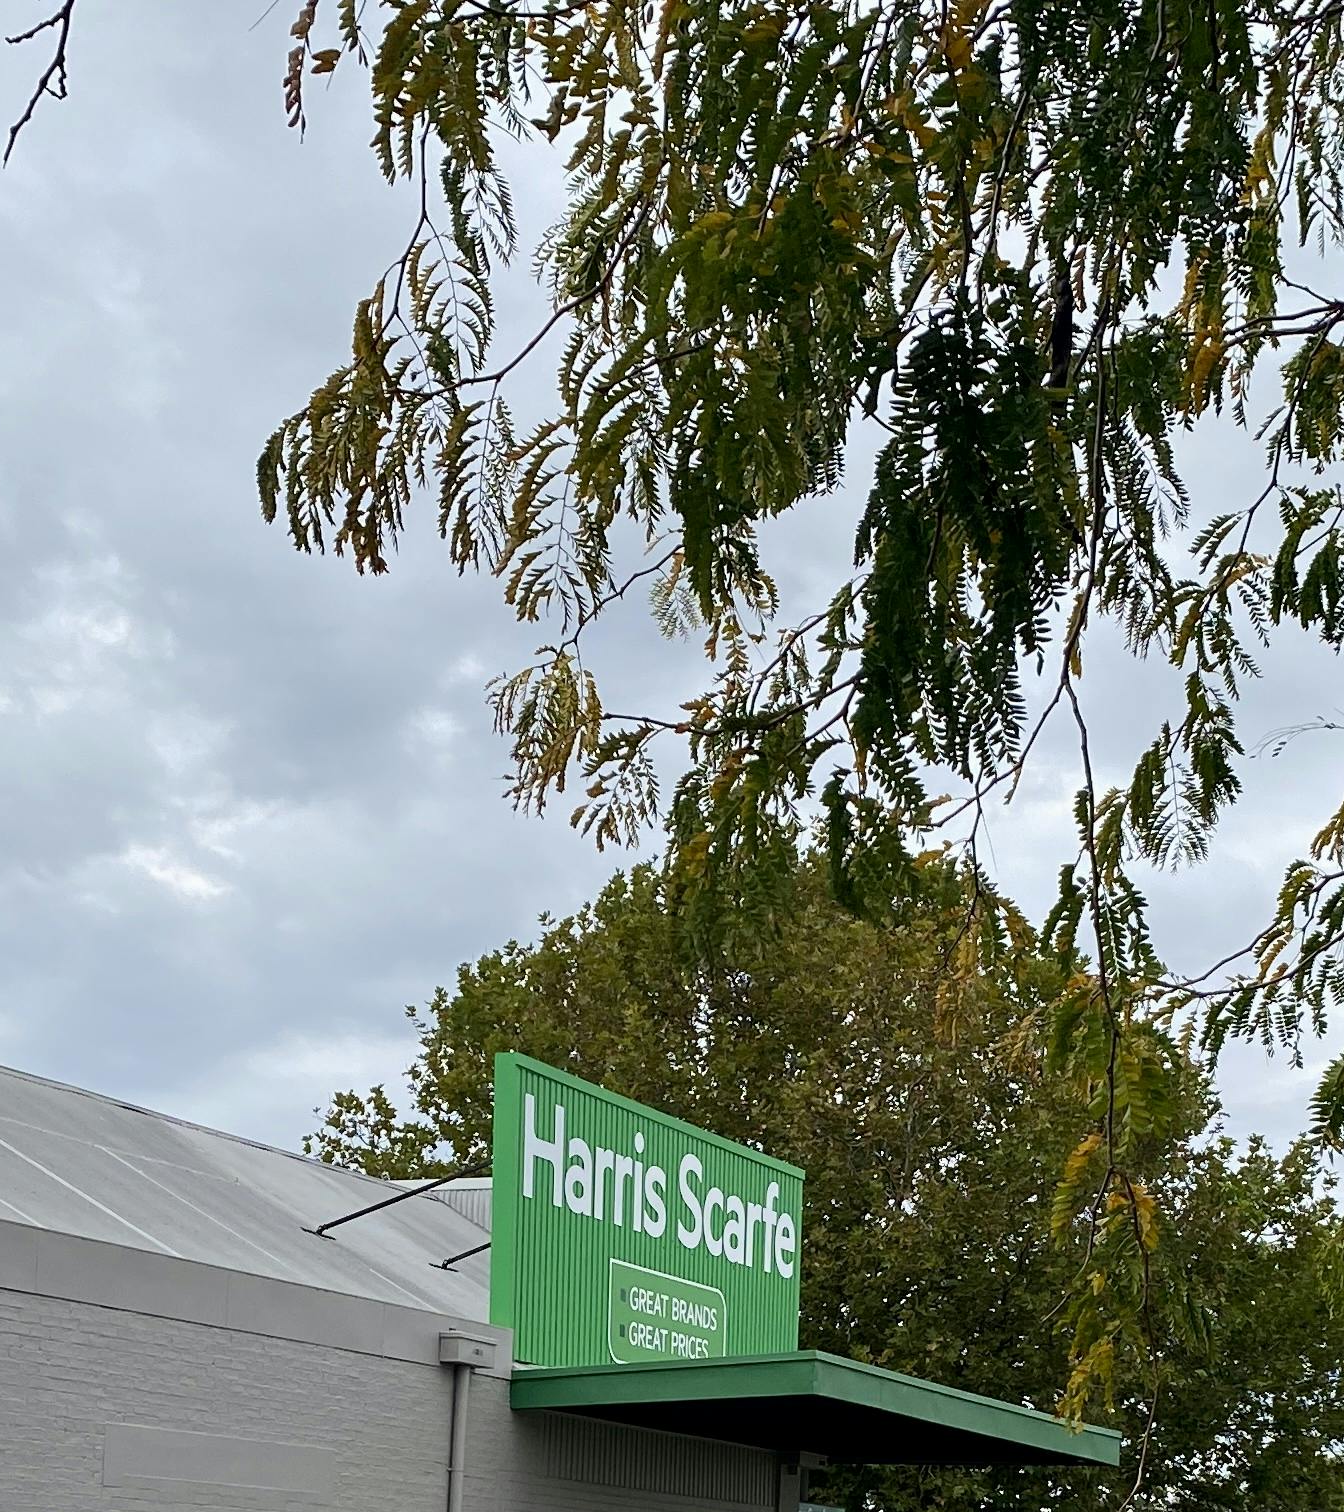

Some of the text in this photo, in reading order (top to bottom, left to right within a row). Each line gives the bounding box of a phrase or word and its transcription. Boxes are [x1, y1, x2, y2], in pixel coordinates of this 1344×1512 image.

[522, 1093, 796, 1279] Harris Scarfe
[629, 1286, 717, 1331] GREAT BRANDS
[628, 1321, 709, 1359] GREAT PRICES
